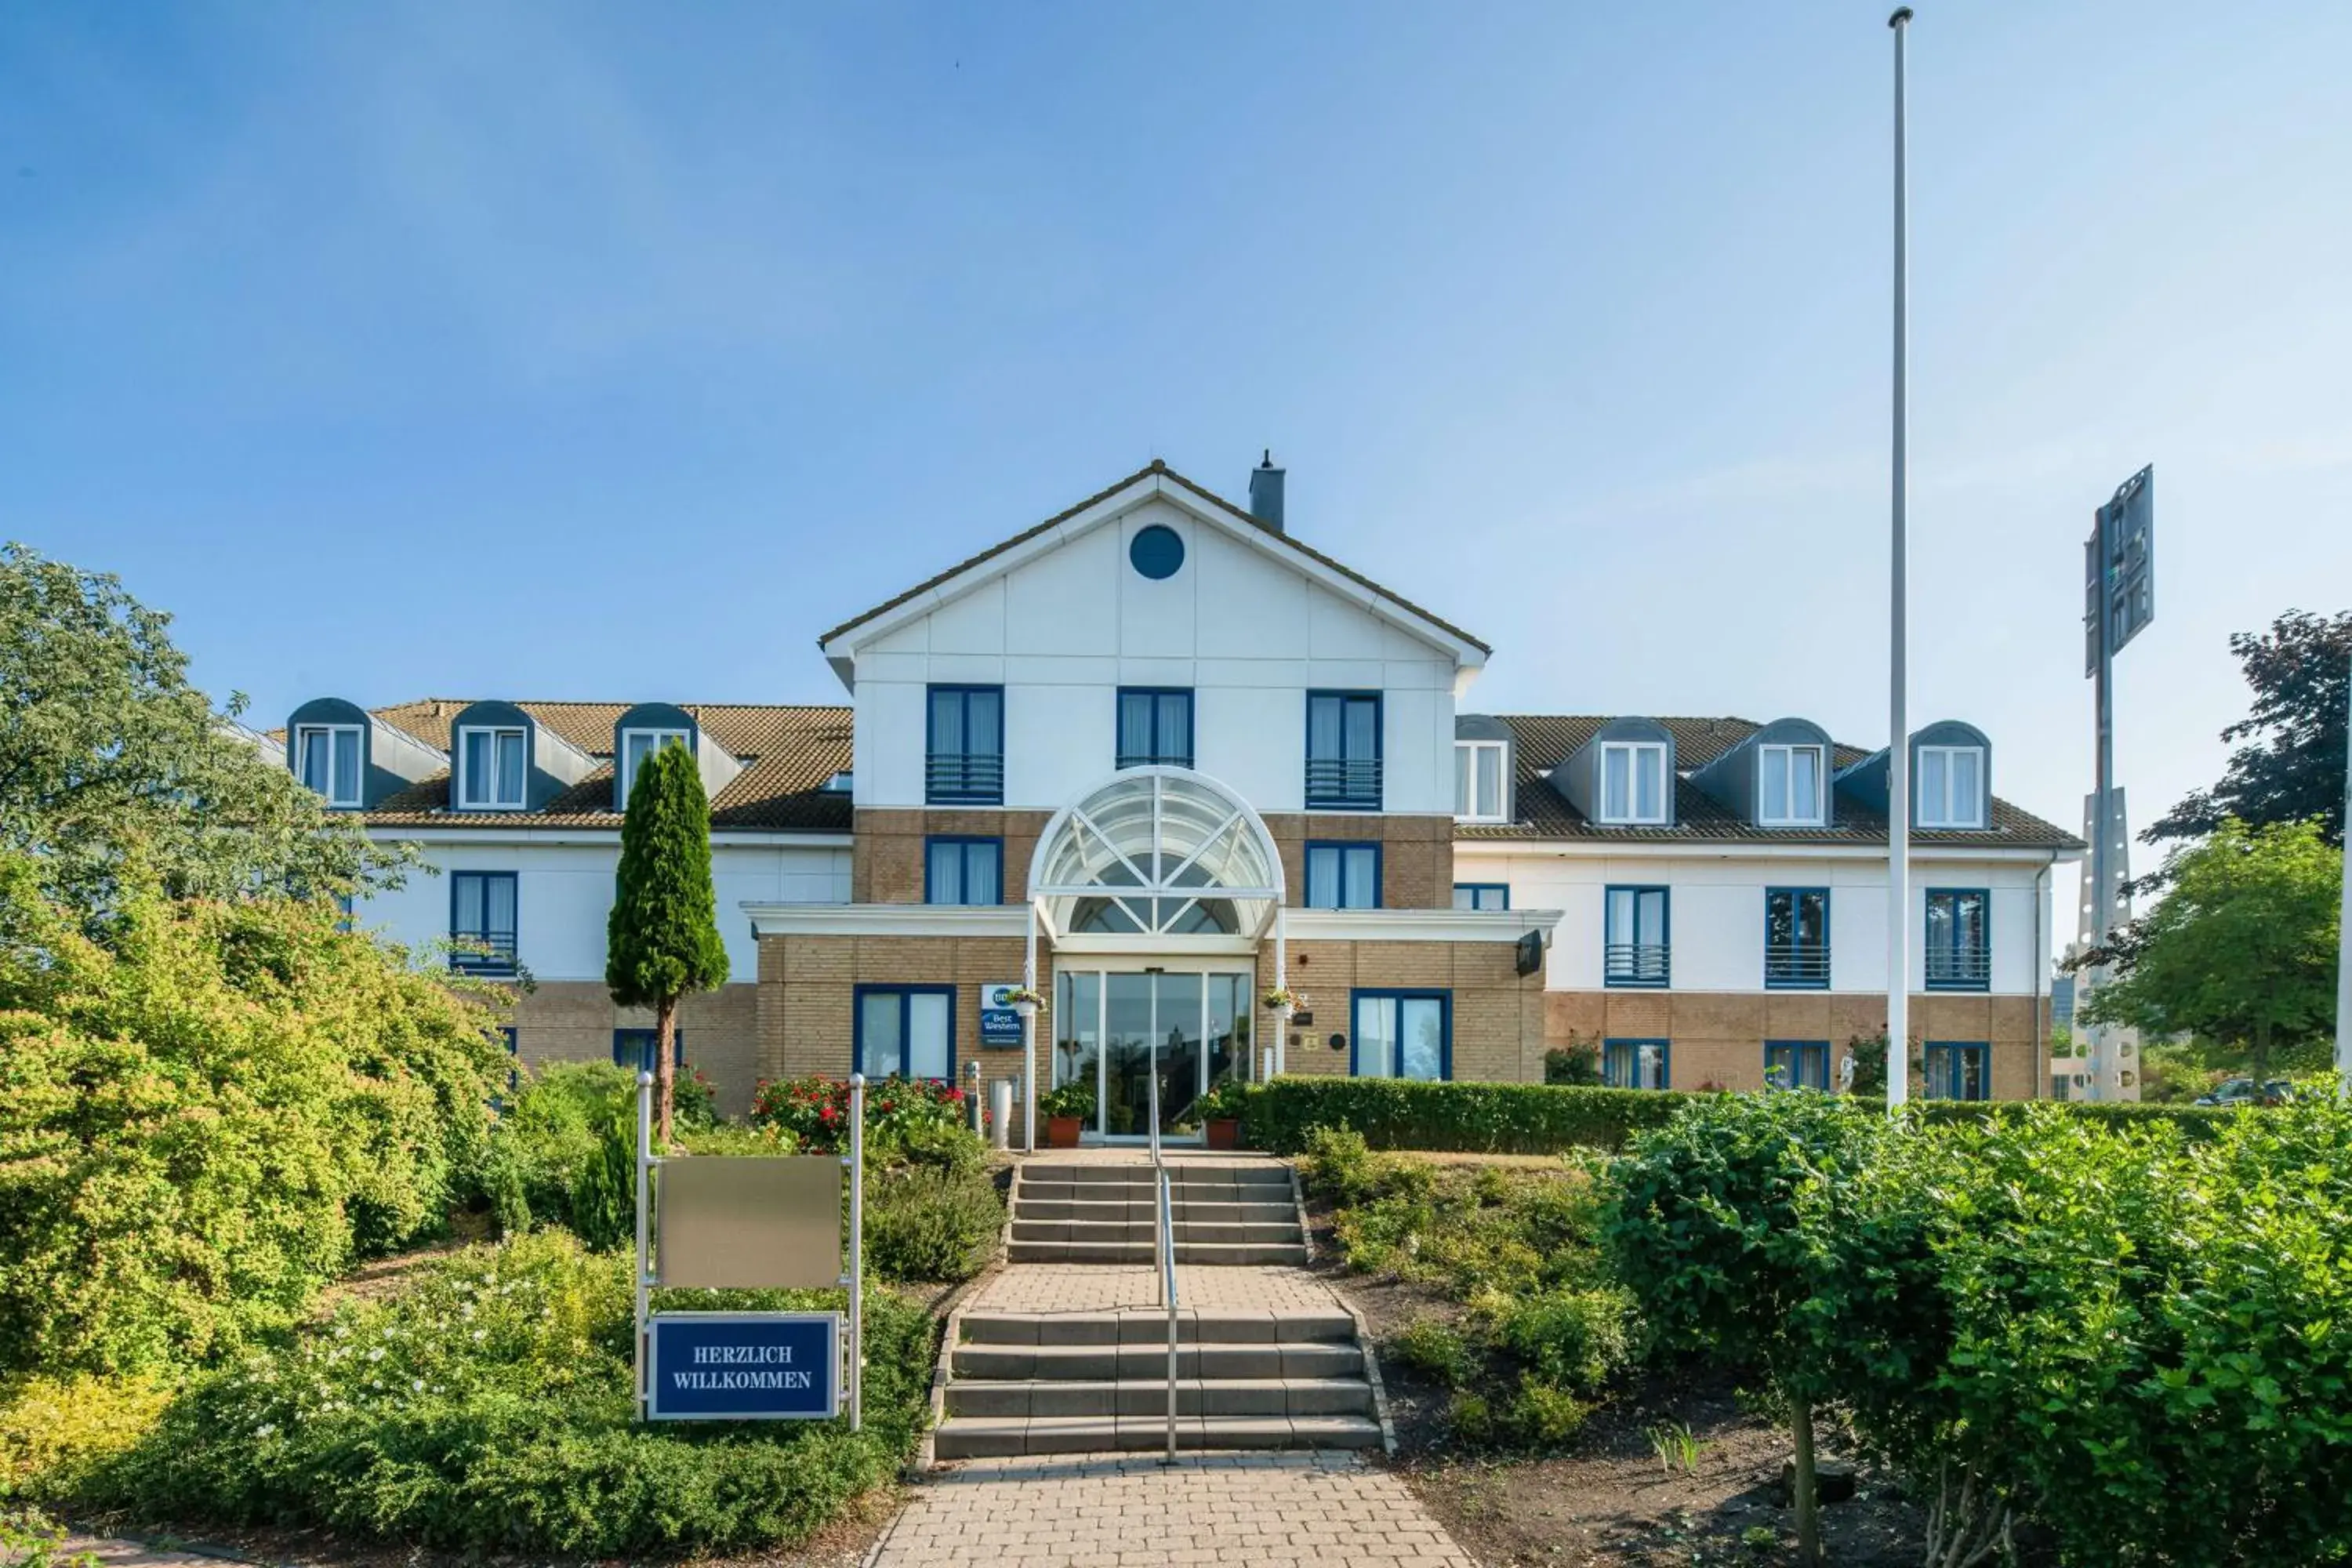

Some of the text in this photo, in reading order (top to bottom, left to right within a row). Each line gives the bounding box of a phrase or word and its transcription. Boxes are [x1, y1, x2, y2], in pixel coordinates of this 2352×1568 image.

[993, 1014, 1013, 1023] Best
[693, 1346, 793, 1363] HERZLICH
[673, 1371, 812, 1389] WILLKOMMEN
